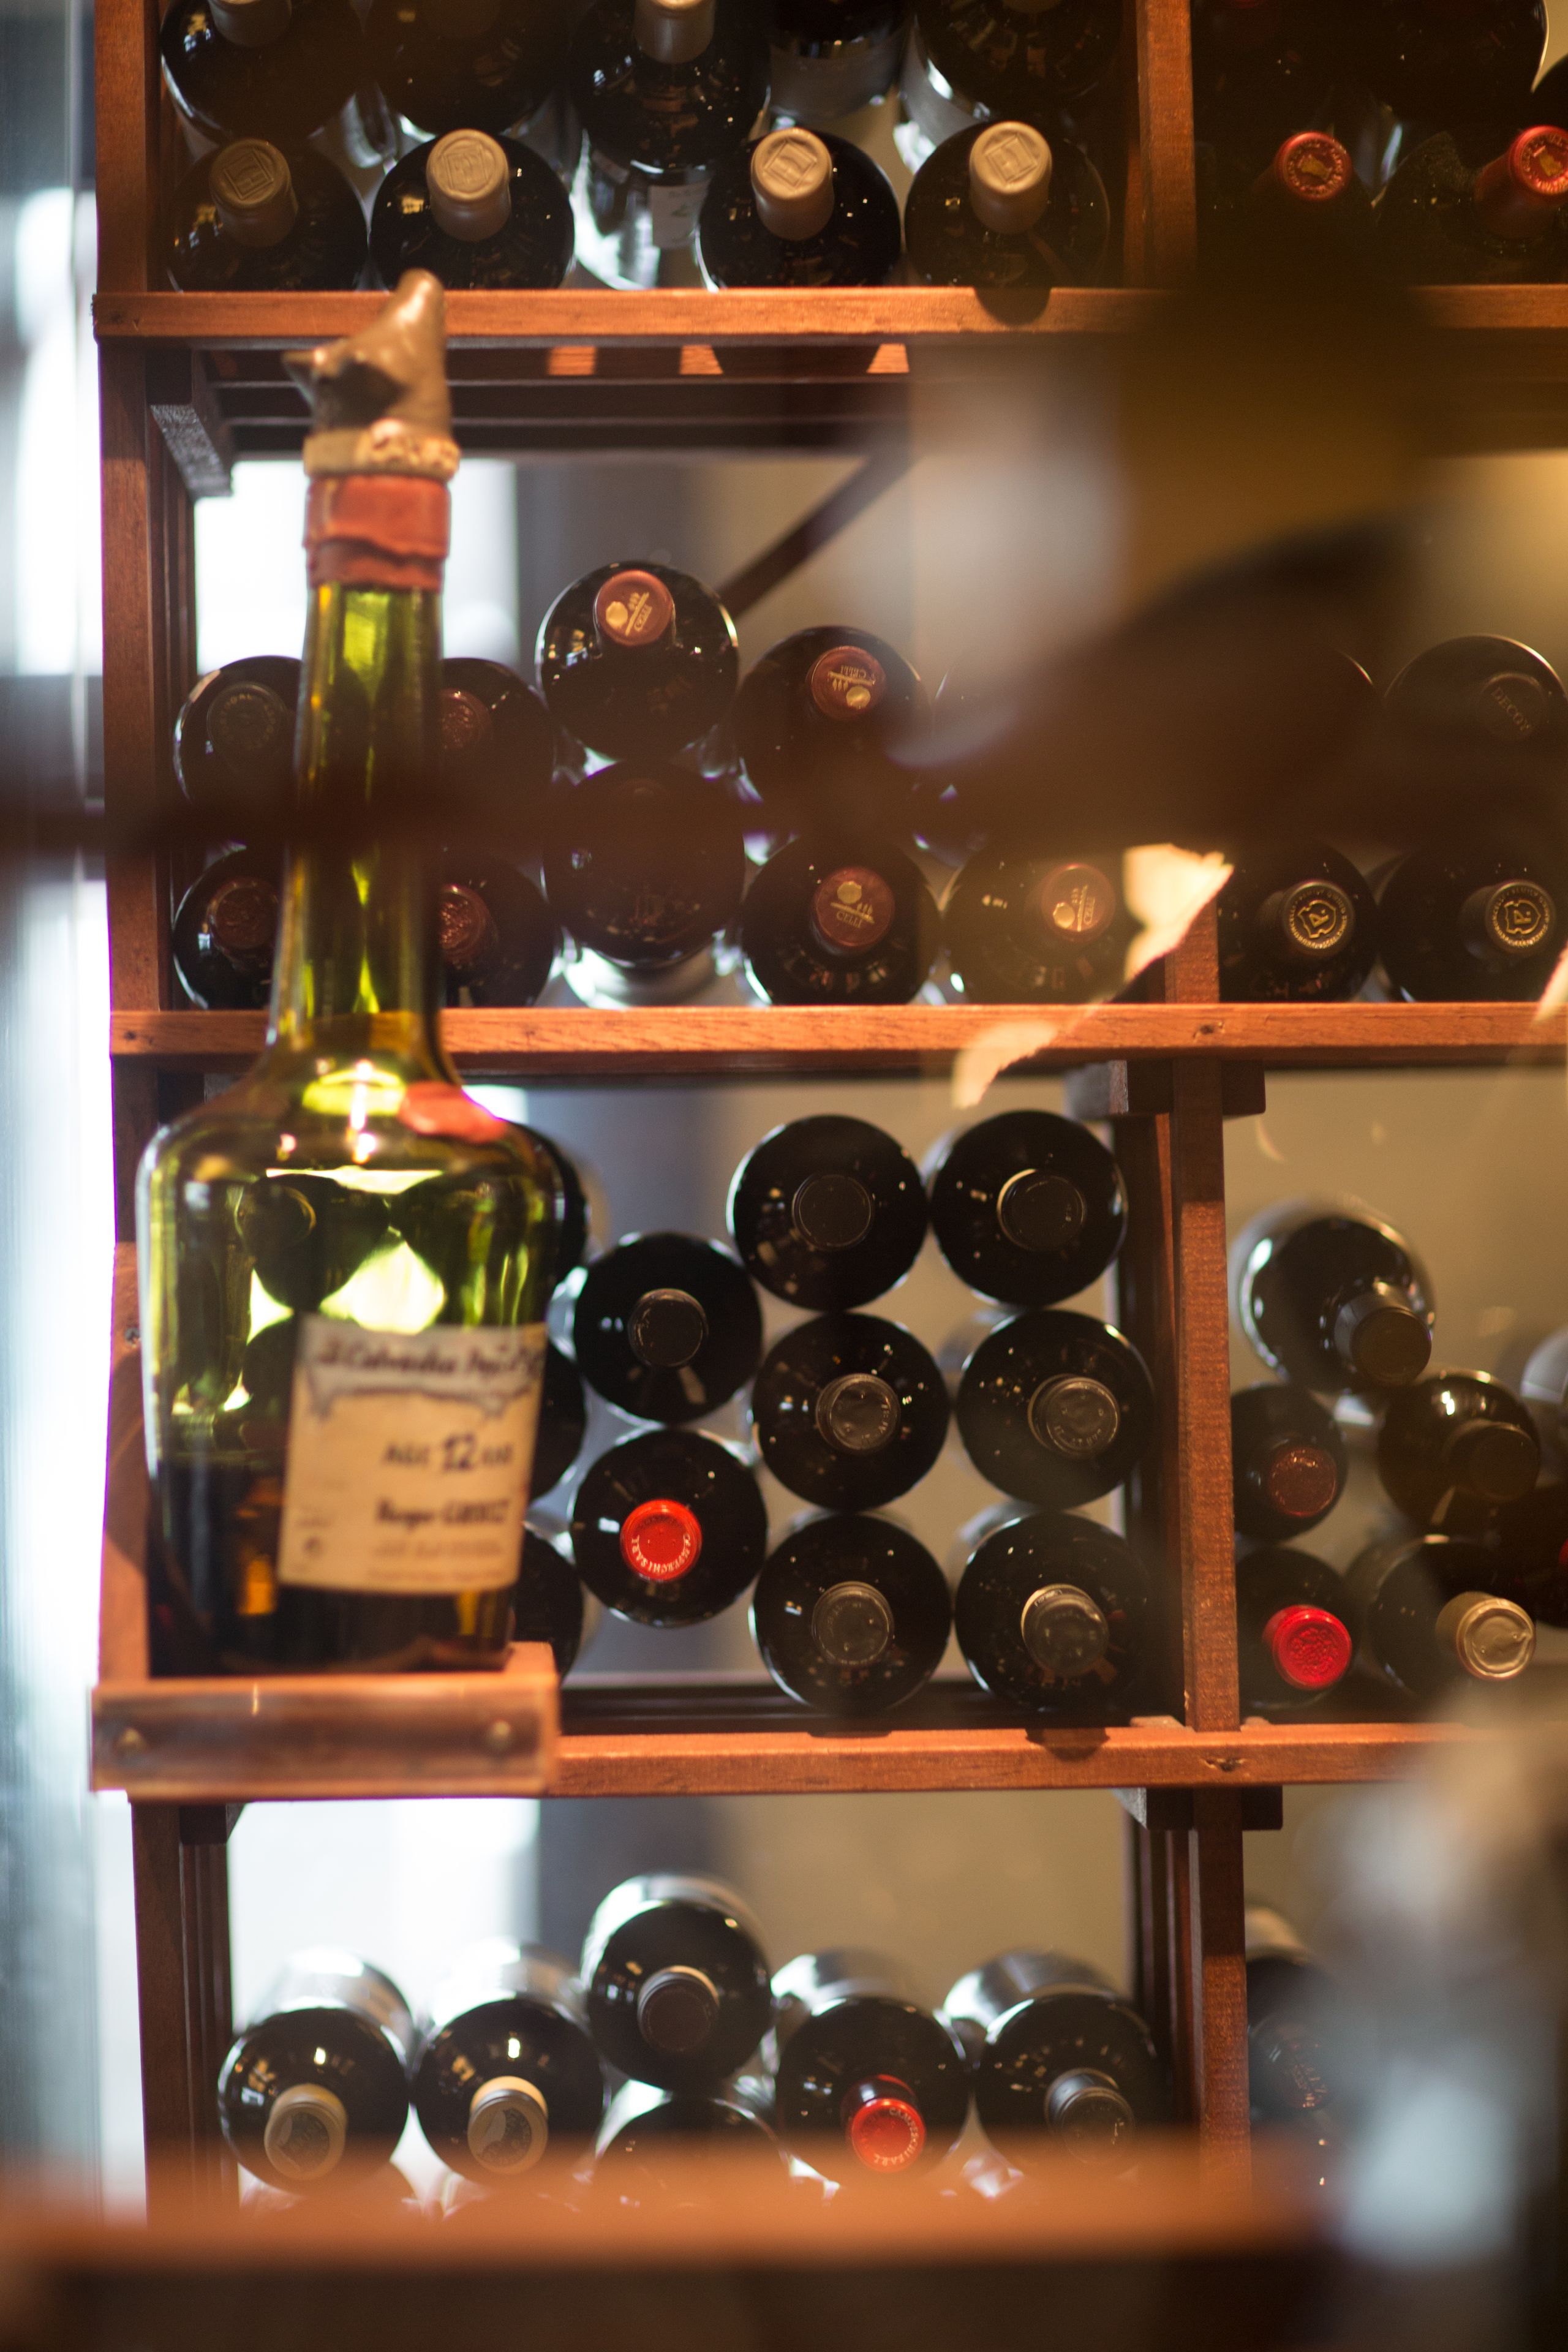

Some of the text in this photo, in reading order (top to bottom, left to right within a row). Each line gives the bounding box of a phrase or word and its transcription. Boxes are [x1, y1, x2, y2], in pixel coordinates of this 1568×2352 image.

[634, 603, 652, 632] CELLI
[840, 665, 867, 680] CELLI
[1490, 685, 1532, 733] DECOY
[836, 910, 863, 929] CELLI
[442, 1431, 477, 1473] 12
